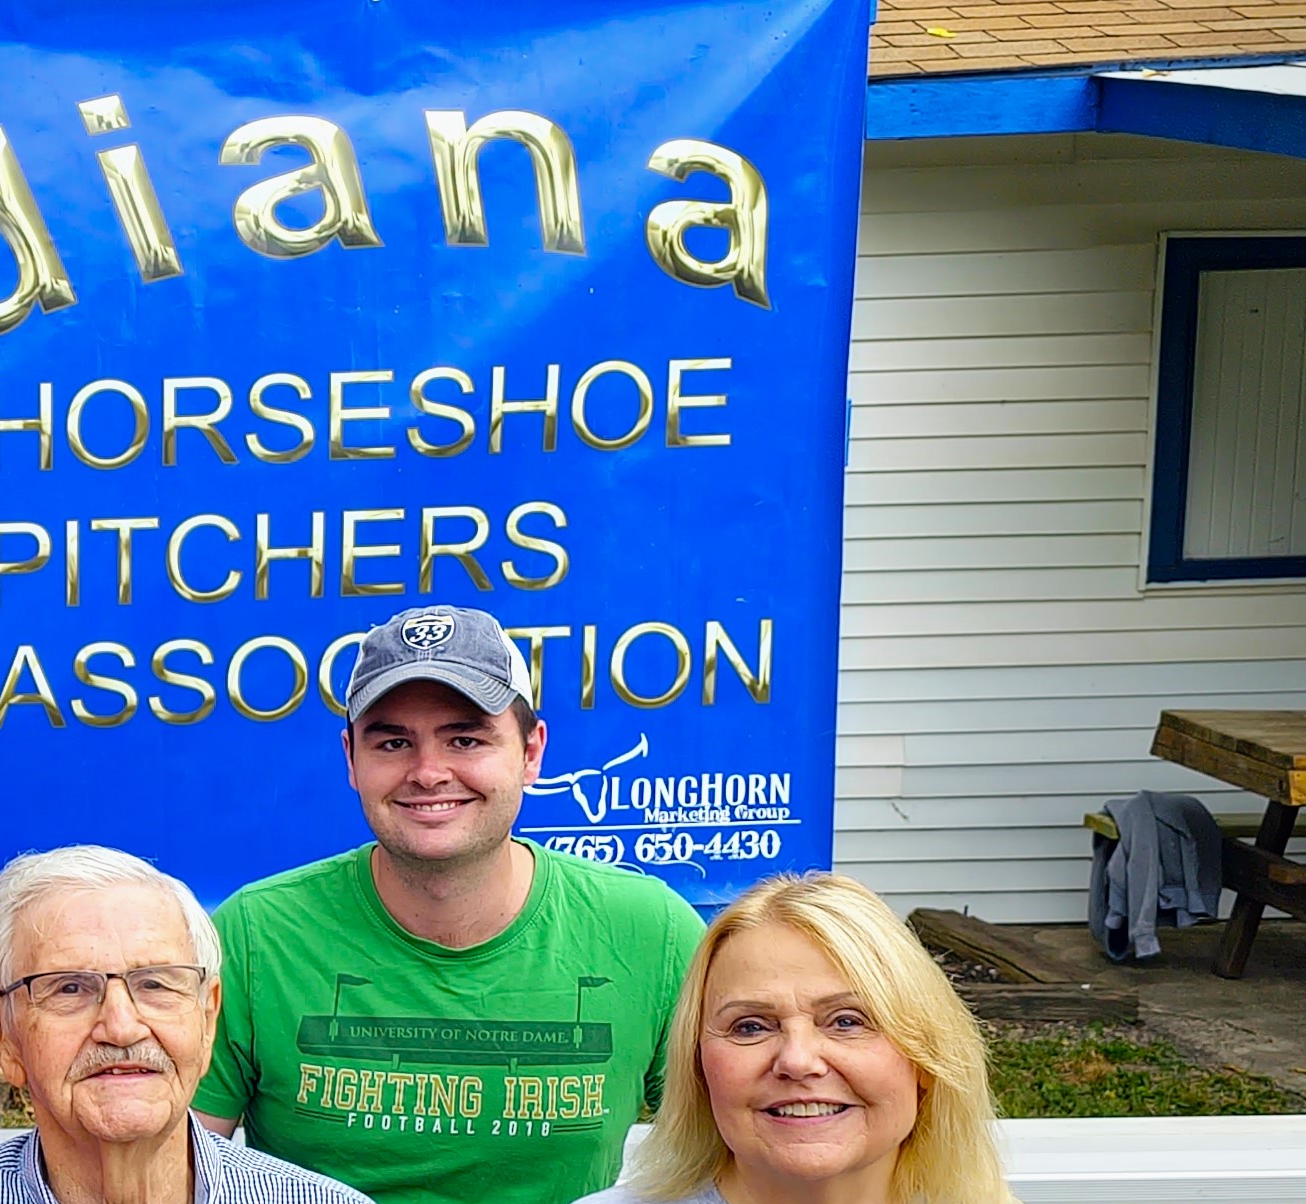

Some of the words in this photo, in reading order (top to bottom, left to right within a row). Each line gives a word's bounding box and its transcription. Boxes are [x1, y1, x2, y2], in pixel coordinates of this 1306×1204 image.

[409, 624, 448, 643] 33
[610, 773, 791, 811] LONGHORN
[644, 804, 731, 825] Marketing
[734, 804, 790, 822] Group
[634, 829, 782, 864] 650-4430
[349, 1025, 438, 1040] UNIVERSITY
[444, 1027, 461, 1040] OF
[464, 1028, 518, 1042] NOTRE
[297, 1063, 483, 1118] FIGHTING
[502, 1074, 606, 1120] IRISH
[347, 1112, 476, 1135] FOOTBALL
[491, 1120, 551, 1137] 2018
